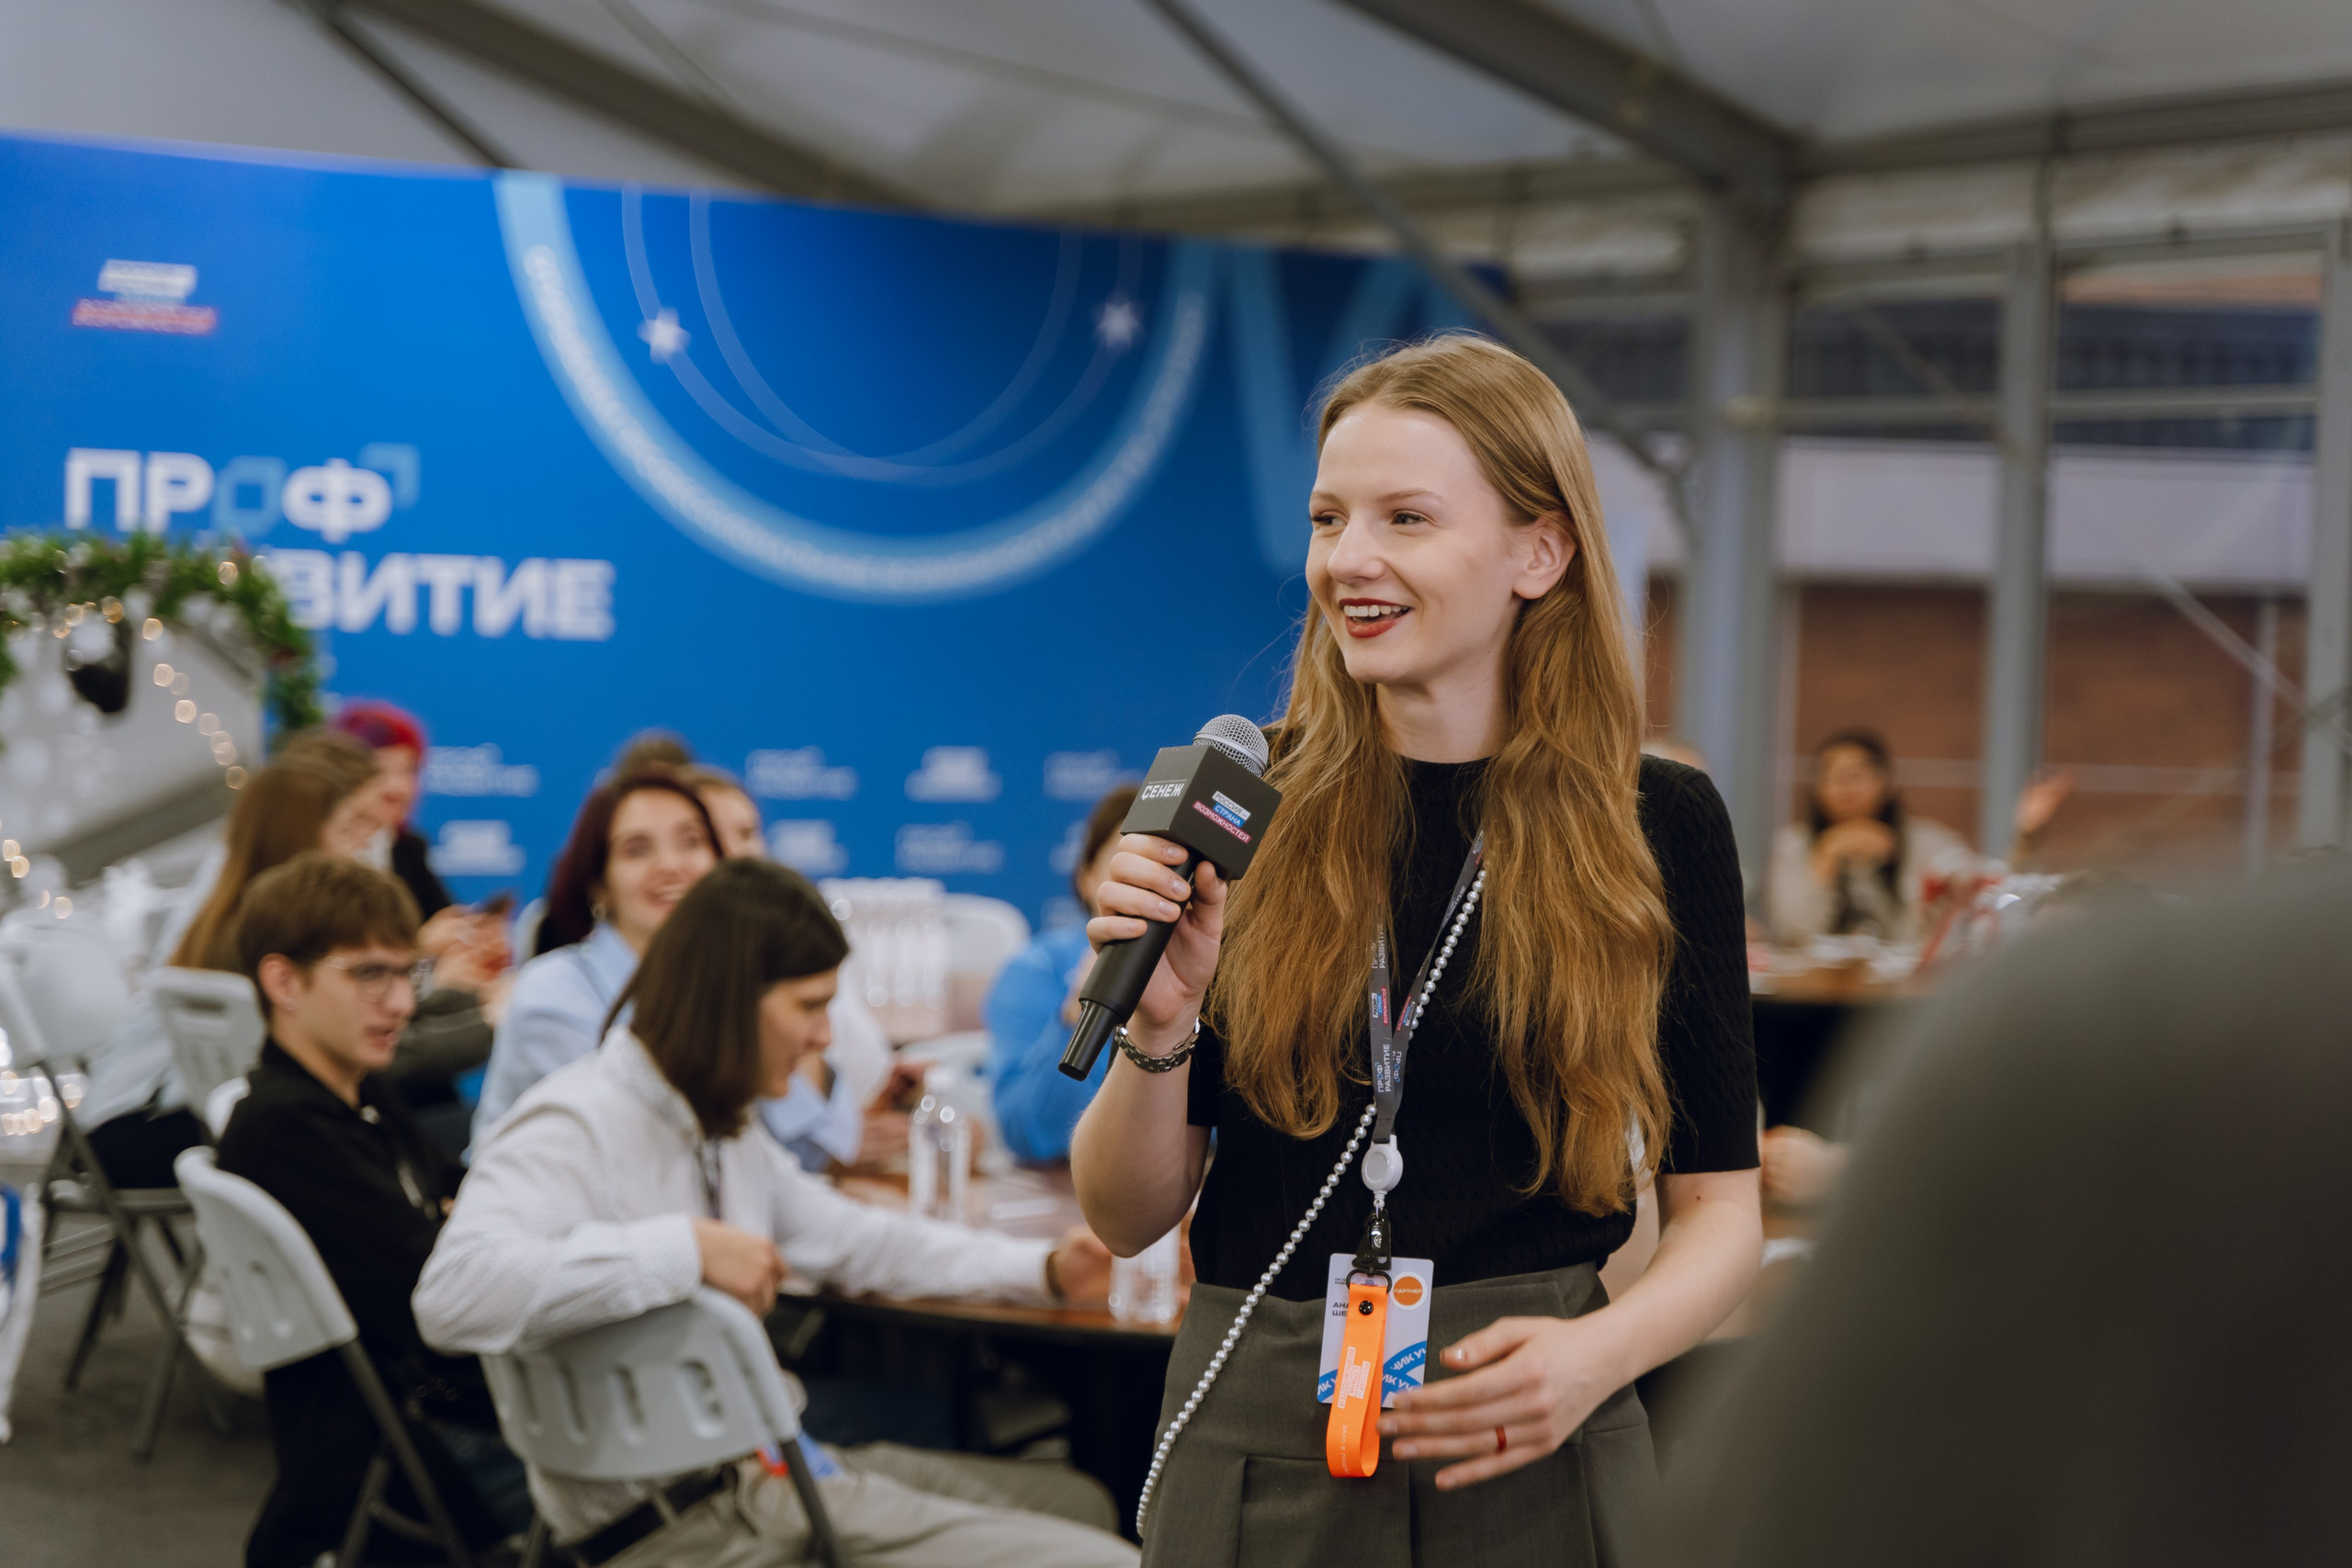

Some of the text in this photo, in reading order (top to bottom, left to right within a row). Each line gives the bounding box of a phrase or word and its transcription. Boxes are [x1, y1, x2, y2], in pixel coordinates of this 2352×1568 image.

[64, 447, 393, 544] ПРОФ
[272, 547, 616, 642] ВИТИЕ
[1141, 783, 1185, 801] СЕНЕЖ
[1215, 793, 1242, 815] РОССИЯ
[1194, 802, 1250, 842] ВОЗМОЖНОСТЕЙ
[1215, 805, 1241, 826] СТРАНА
[1376, 1064, 1385, 1093] ПРОФ
[1383, 1043, 1392, 1092] РАЗВИТИЕ
[1393, 1051, 1402, 1080] ПРОФ
